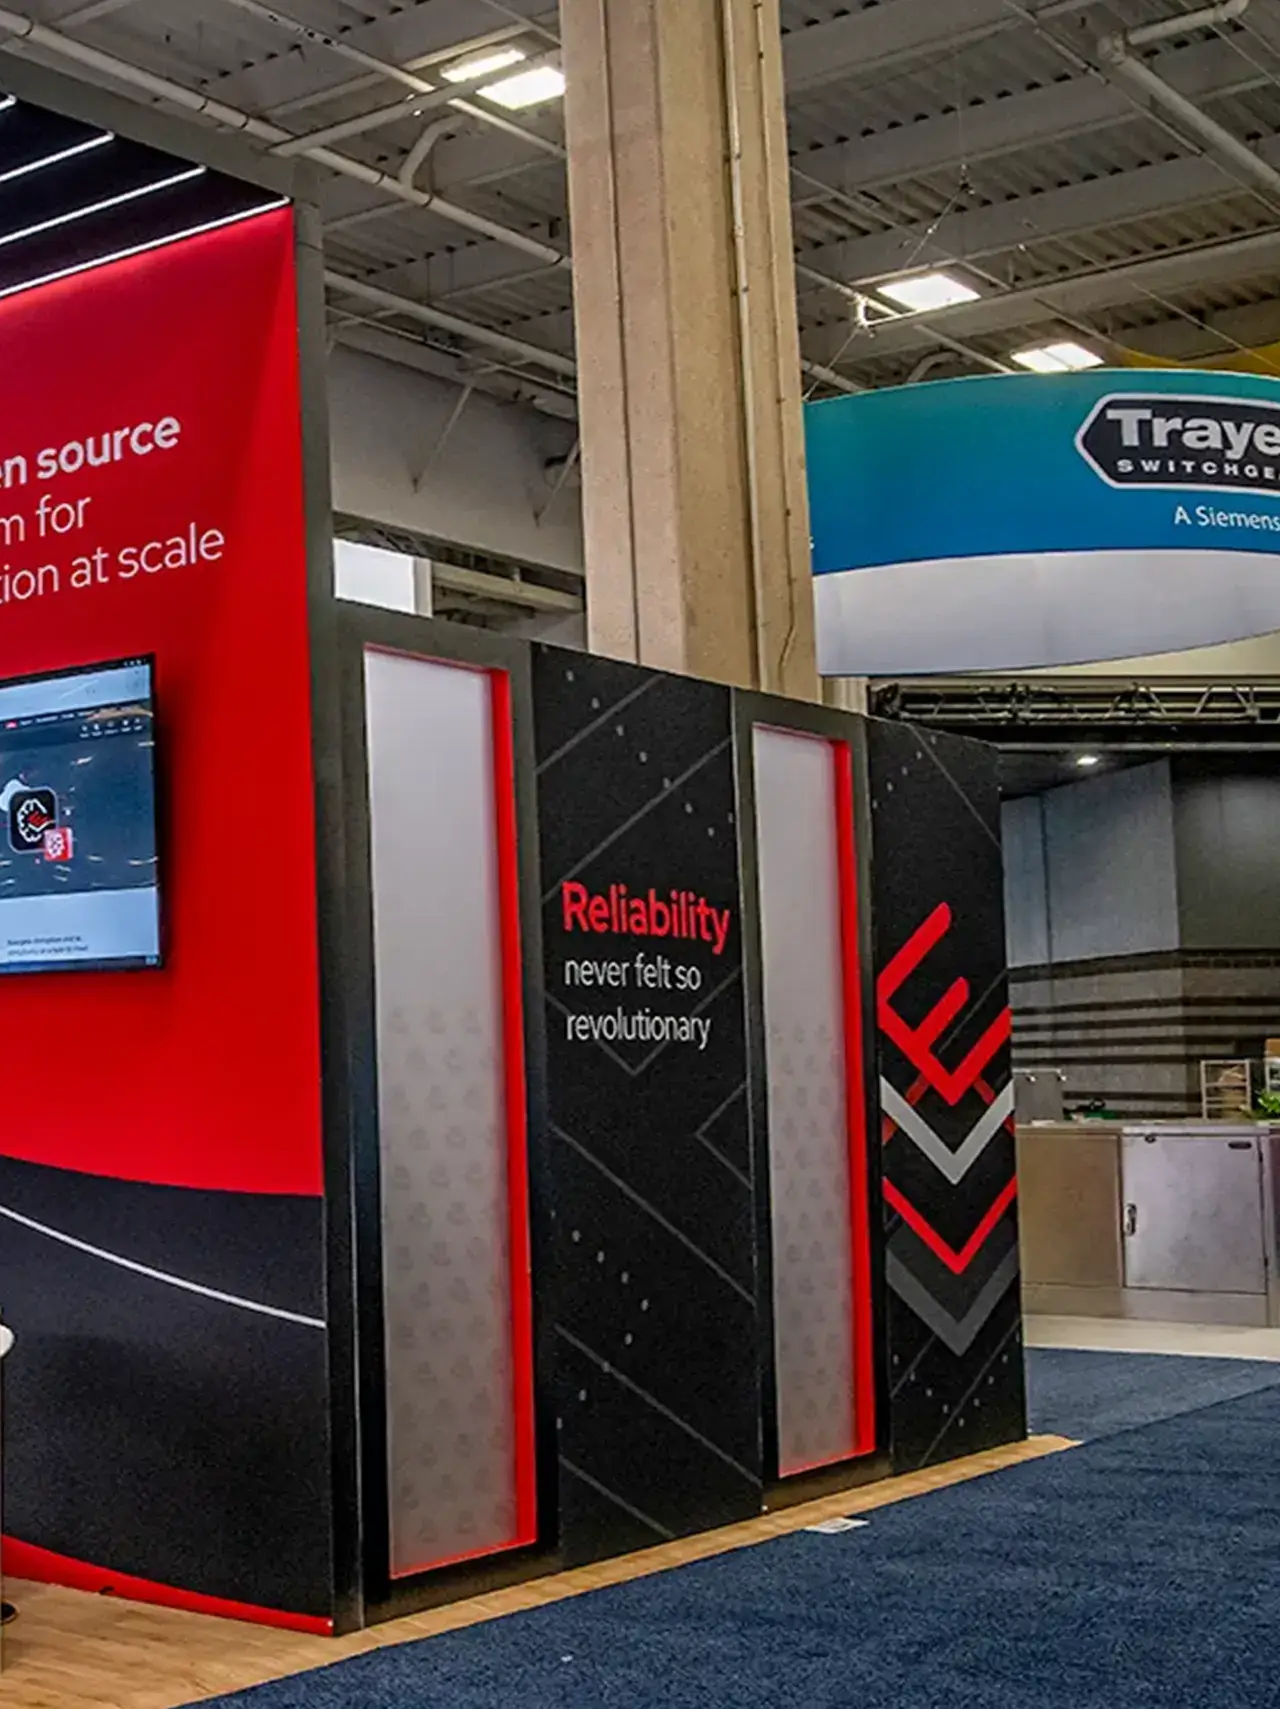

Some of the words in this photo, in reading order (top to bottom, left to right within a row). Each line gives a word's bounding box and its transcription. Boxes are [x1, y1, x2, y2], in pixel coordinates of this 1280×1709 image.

[36, 416, 181, 480] source
[1106, 408, 1280, 460] Traye
[1117, 459, 1280, 480] SWITCHGE
[36, 494, 92, 537] for
[1174, 505, 1192, 525] A
[1195, 505, 1280, 531] Siemens
[70, 547, 110, 588] at
[118, 522, 225, 579] scale
[561, 880, 730, 955] Reliability
[564, 958, 630, 986] never
[634, 952, 672, 989] felt
[675, 965, 701, 991] so
[566, 1006, 711, 1050] revolutionary
